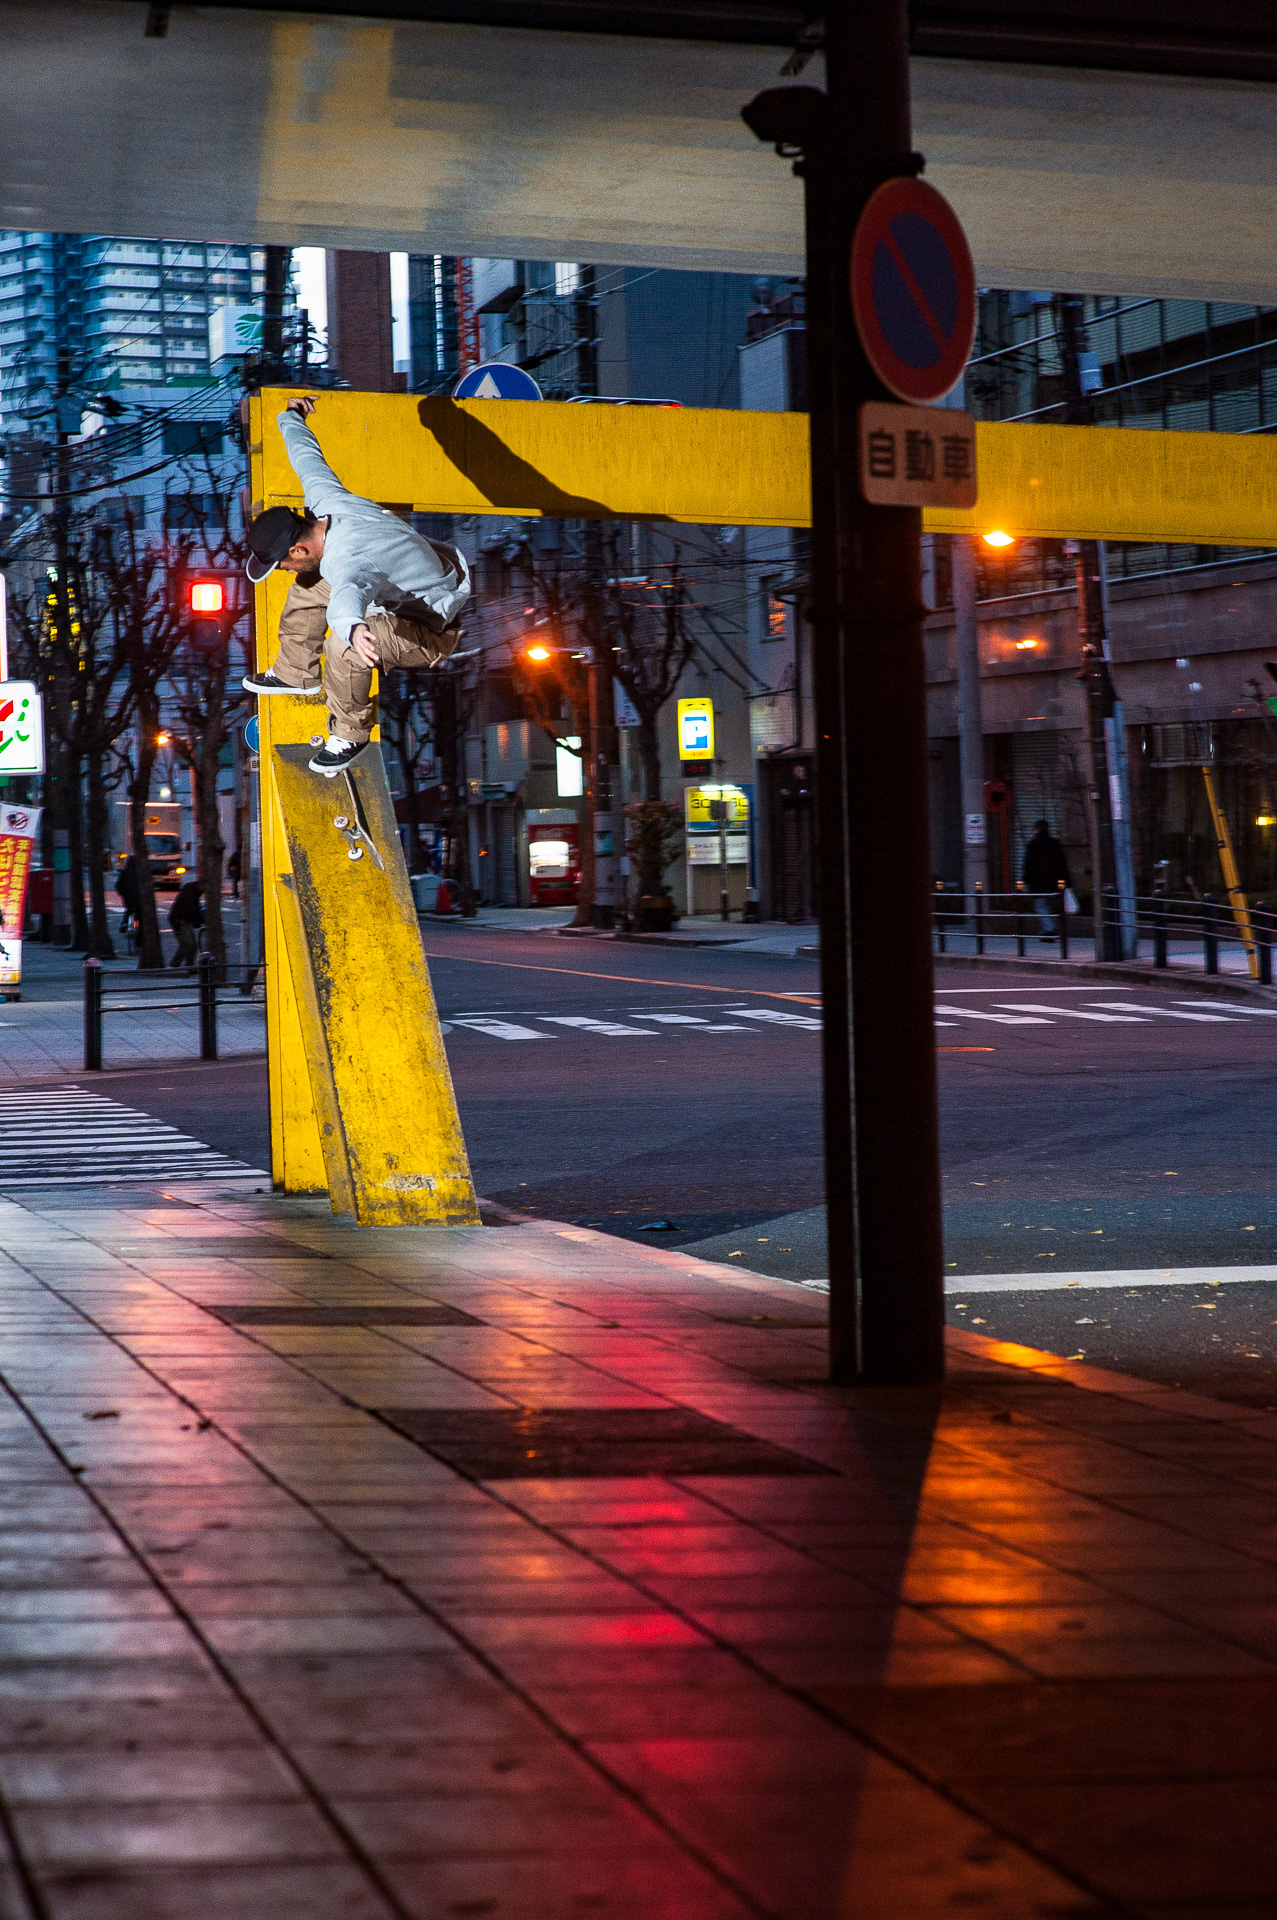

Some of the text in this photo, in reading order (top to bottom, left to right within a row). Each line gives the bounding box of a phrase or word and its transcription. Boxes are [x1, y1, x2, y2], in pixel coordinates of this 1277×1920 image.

[868, 428, 972, 484] 自動車
[685, 719, 707, 746] P
